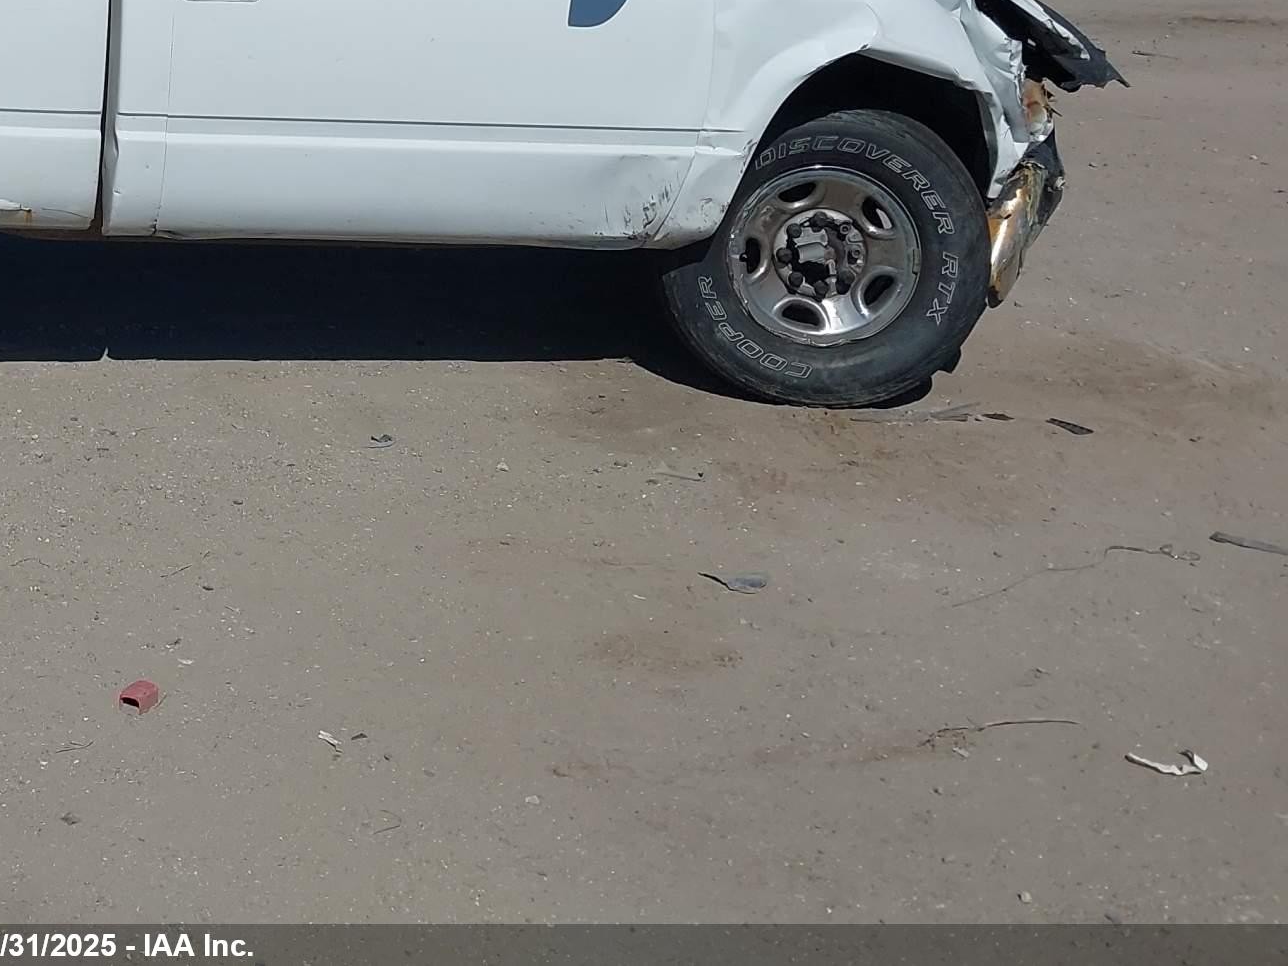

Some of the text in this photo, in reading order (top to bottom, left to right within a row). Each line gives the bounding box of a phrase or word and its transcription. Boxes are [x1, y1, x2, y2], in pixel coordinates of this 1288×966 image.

[754, 135, 960, 327] DISCOVERER RTX
[696, 275, 814, 379] COOPER
